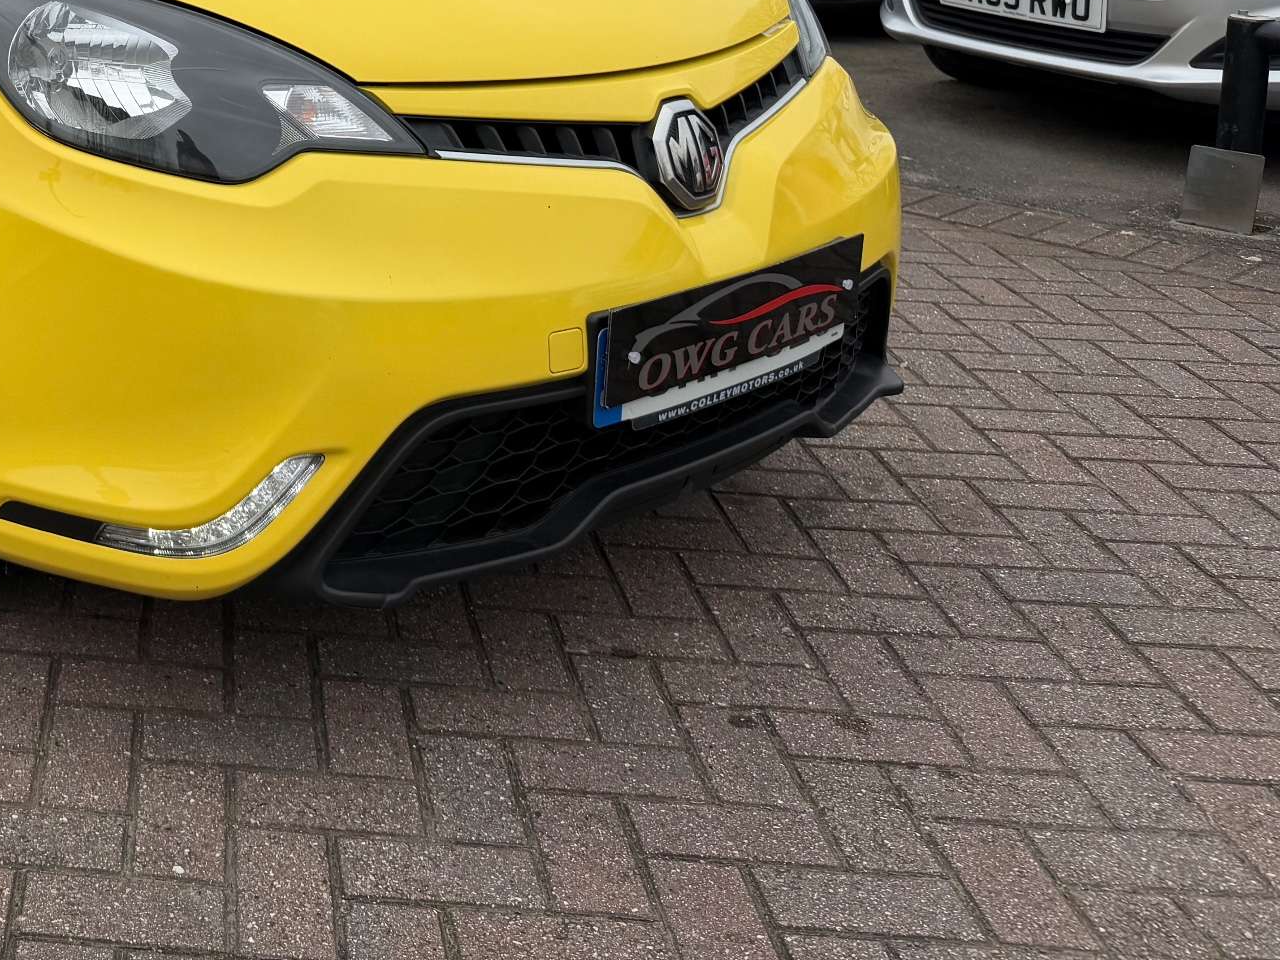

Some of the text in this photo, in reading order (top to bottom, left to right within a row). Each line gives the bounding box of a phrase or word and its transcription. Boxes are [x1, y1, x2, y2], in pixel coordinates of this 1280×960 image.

[668, 114, 722, 192] MG
[637, 293, 838, 391] OWG CARS
